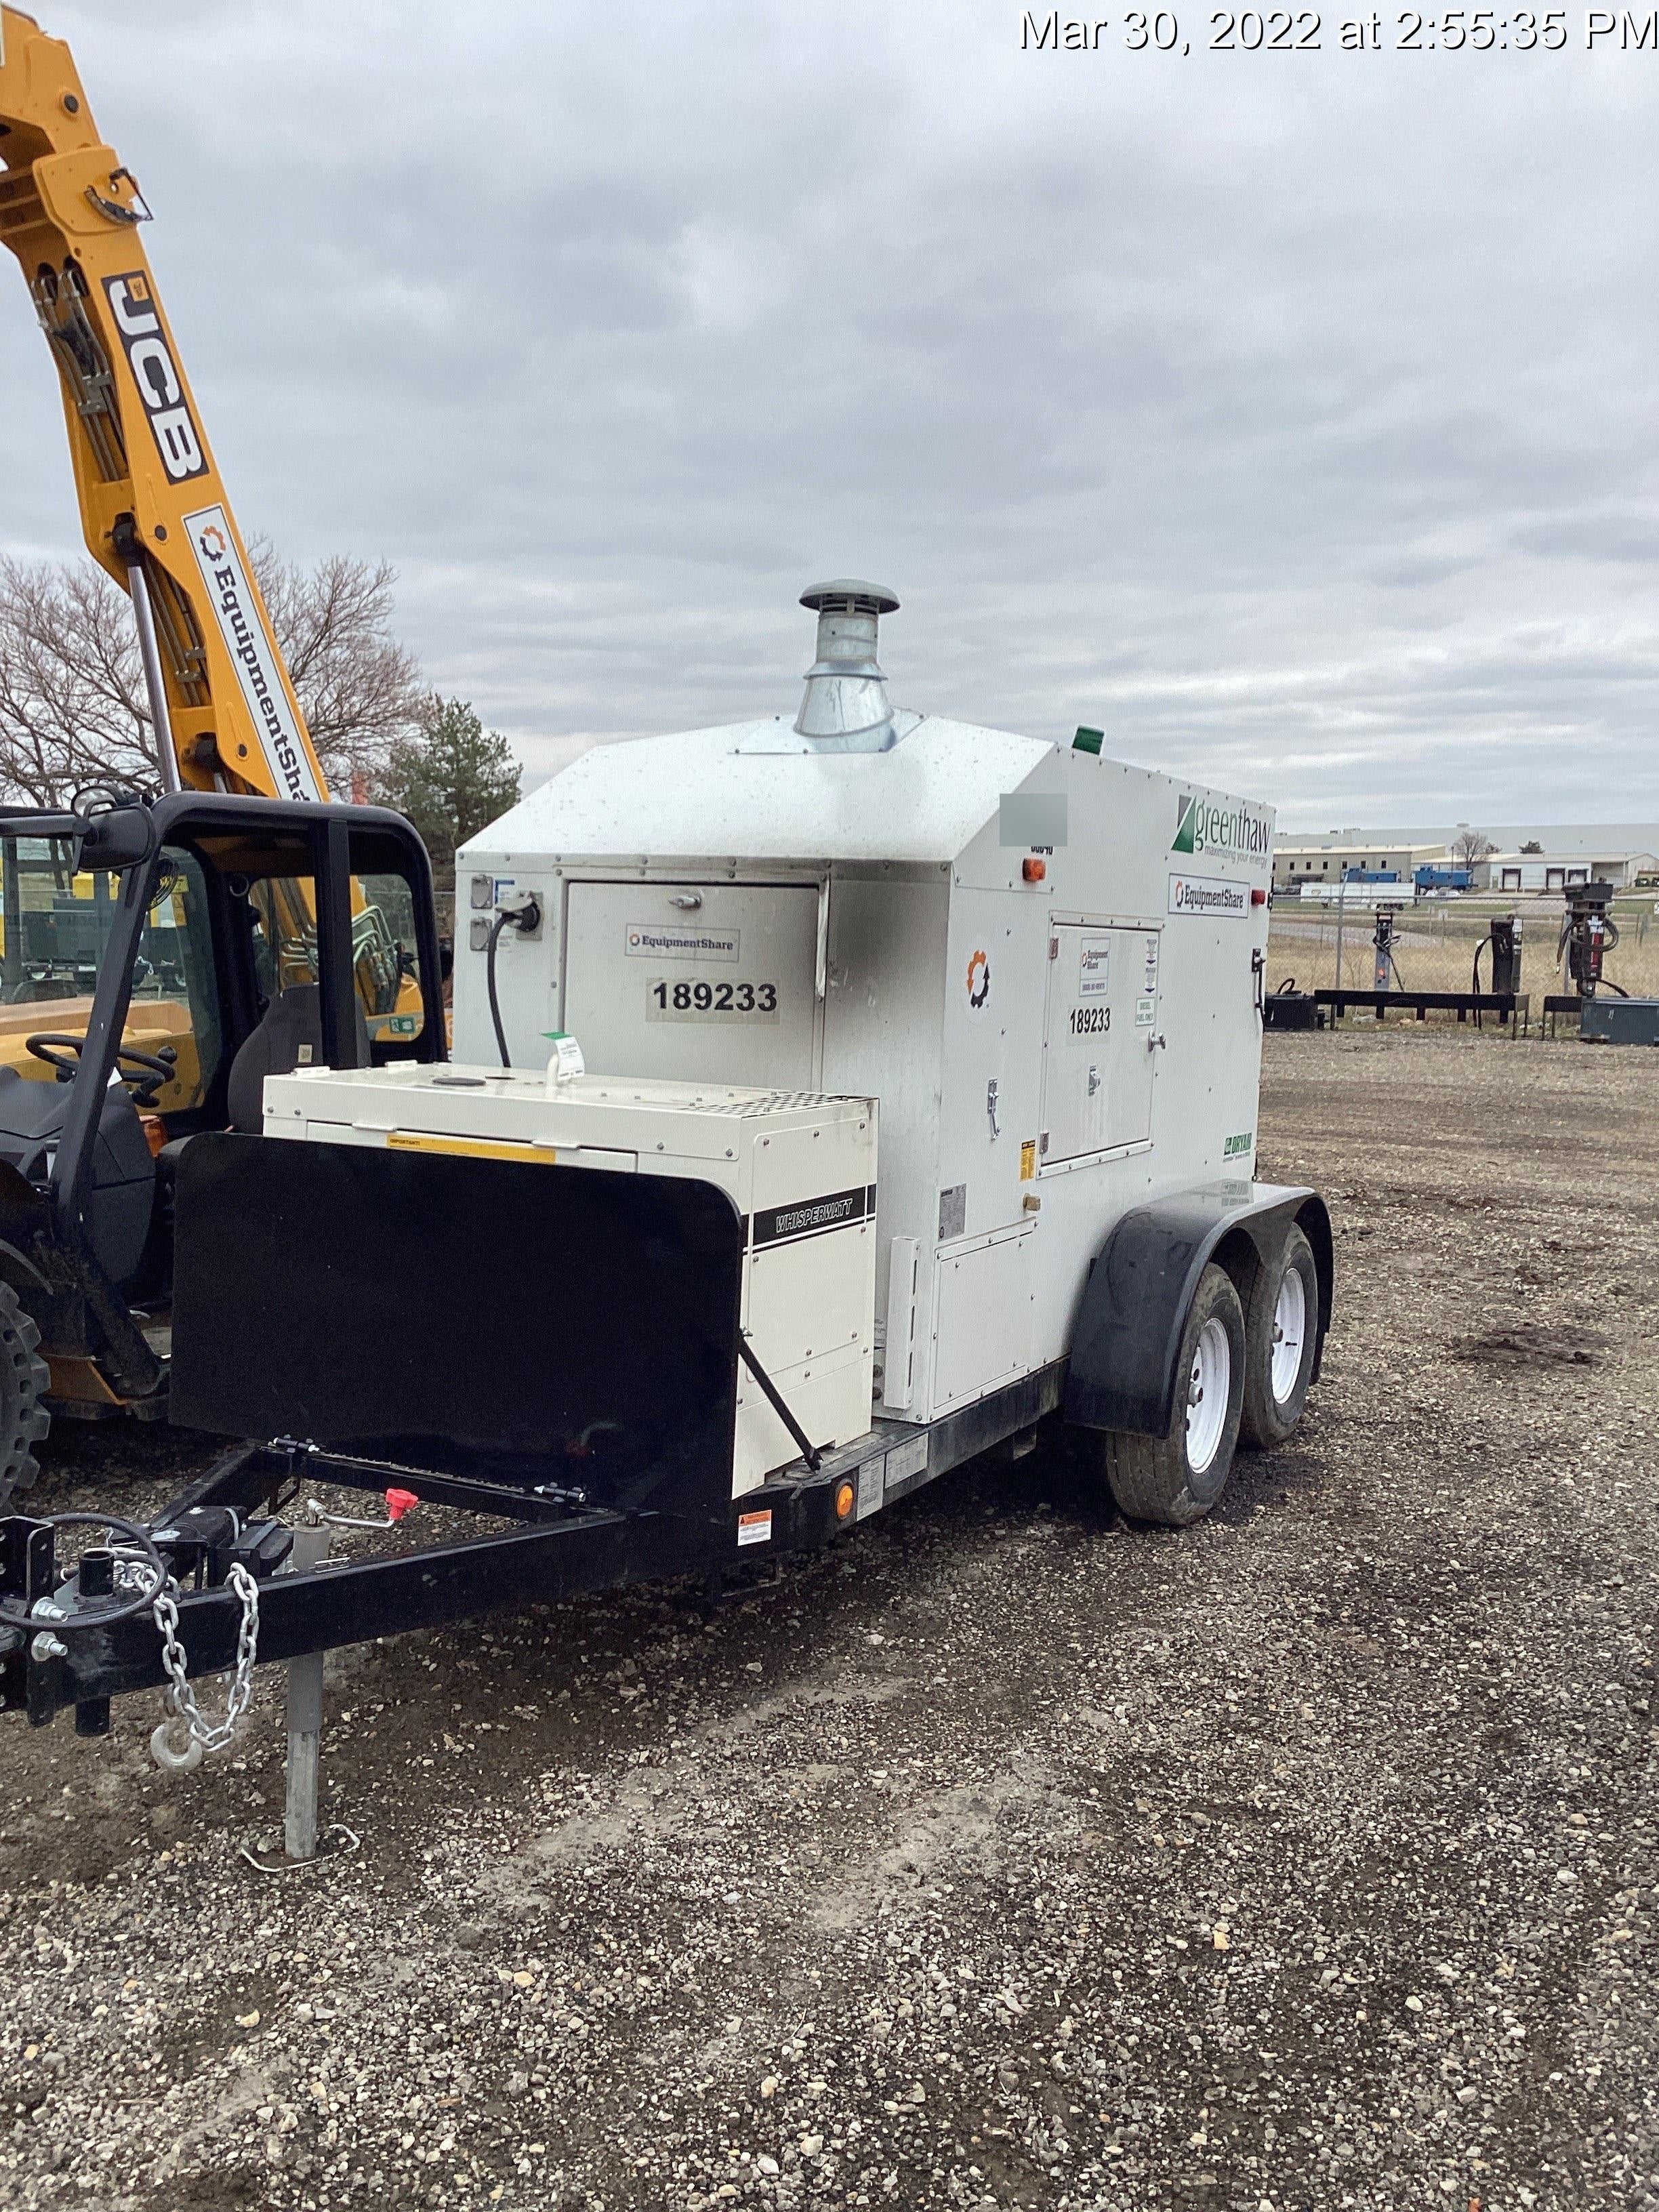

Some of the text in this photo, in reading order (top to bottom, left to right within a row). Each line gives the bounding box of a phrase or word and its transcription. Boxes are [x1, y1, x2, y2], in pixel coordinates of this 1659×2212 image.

[108, 279, 202, 478] JCB
[1195, 799, 1271, 854] greenthaw
[1204, 845, 1268, 869] maximizing your energy
[1185, 884, 1244, 910] EquipmentShare
[642, 935, 734, 949] EquipmentShare
[653, 983, 777, 1012] 189233
[1069, 1008, 1111, 1034] 189233
[776, 1198, 853, 1233] WHISPERWATT
